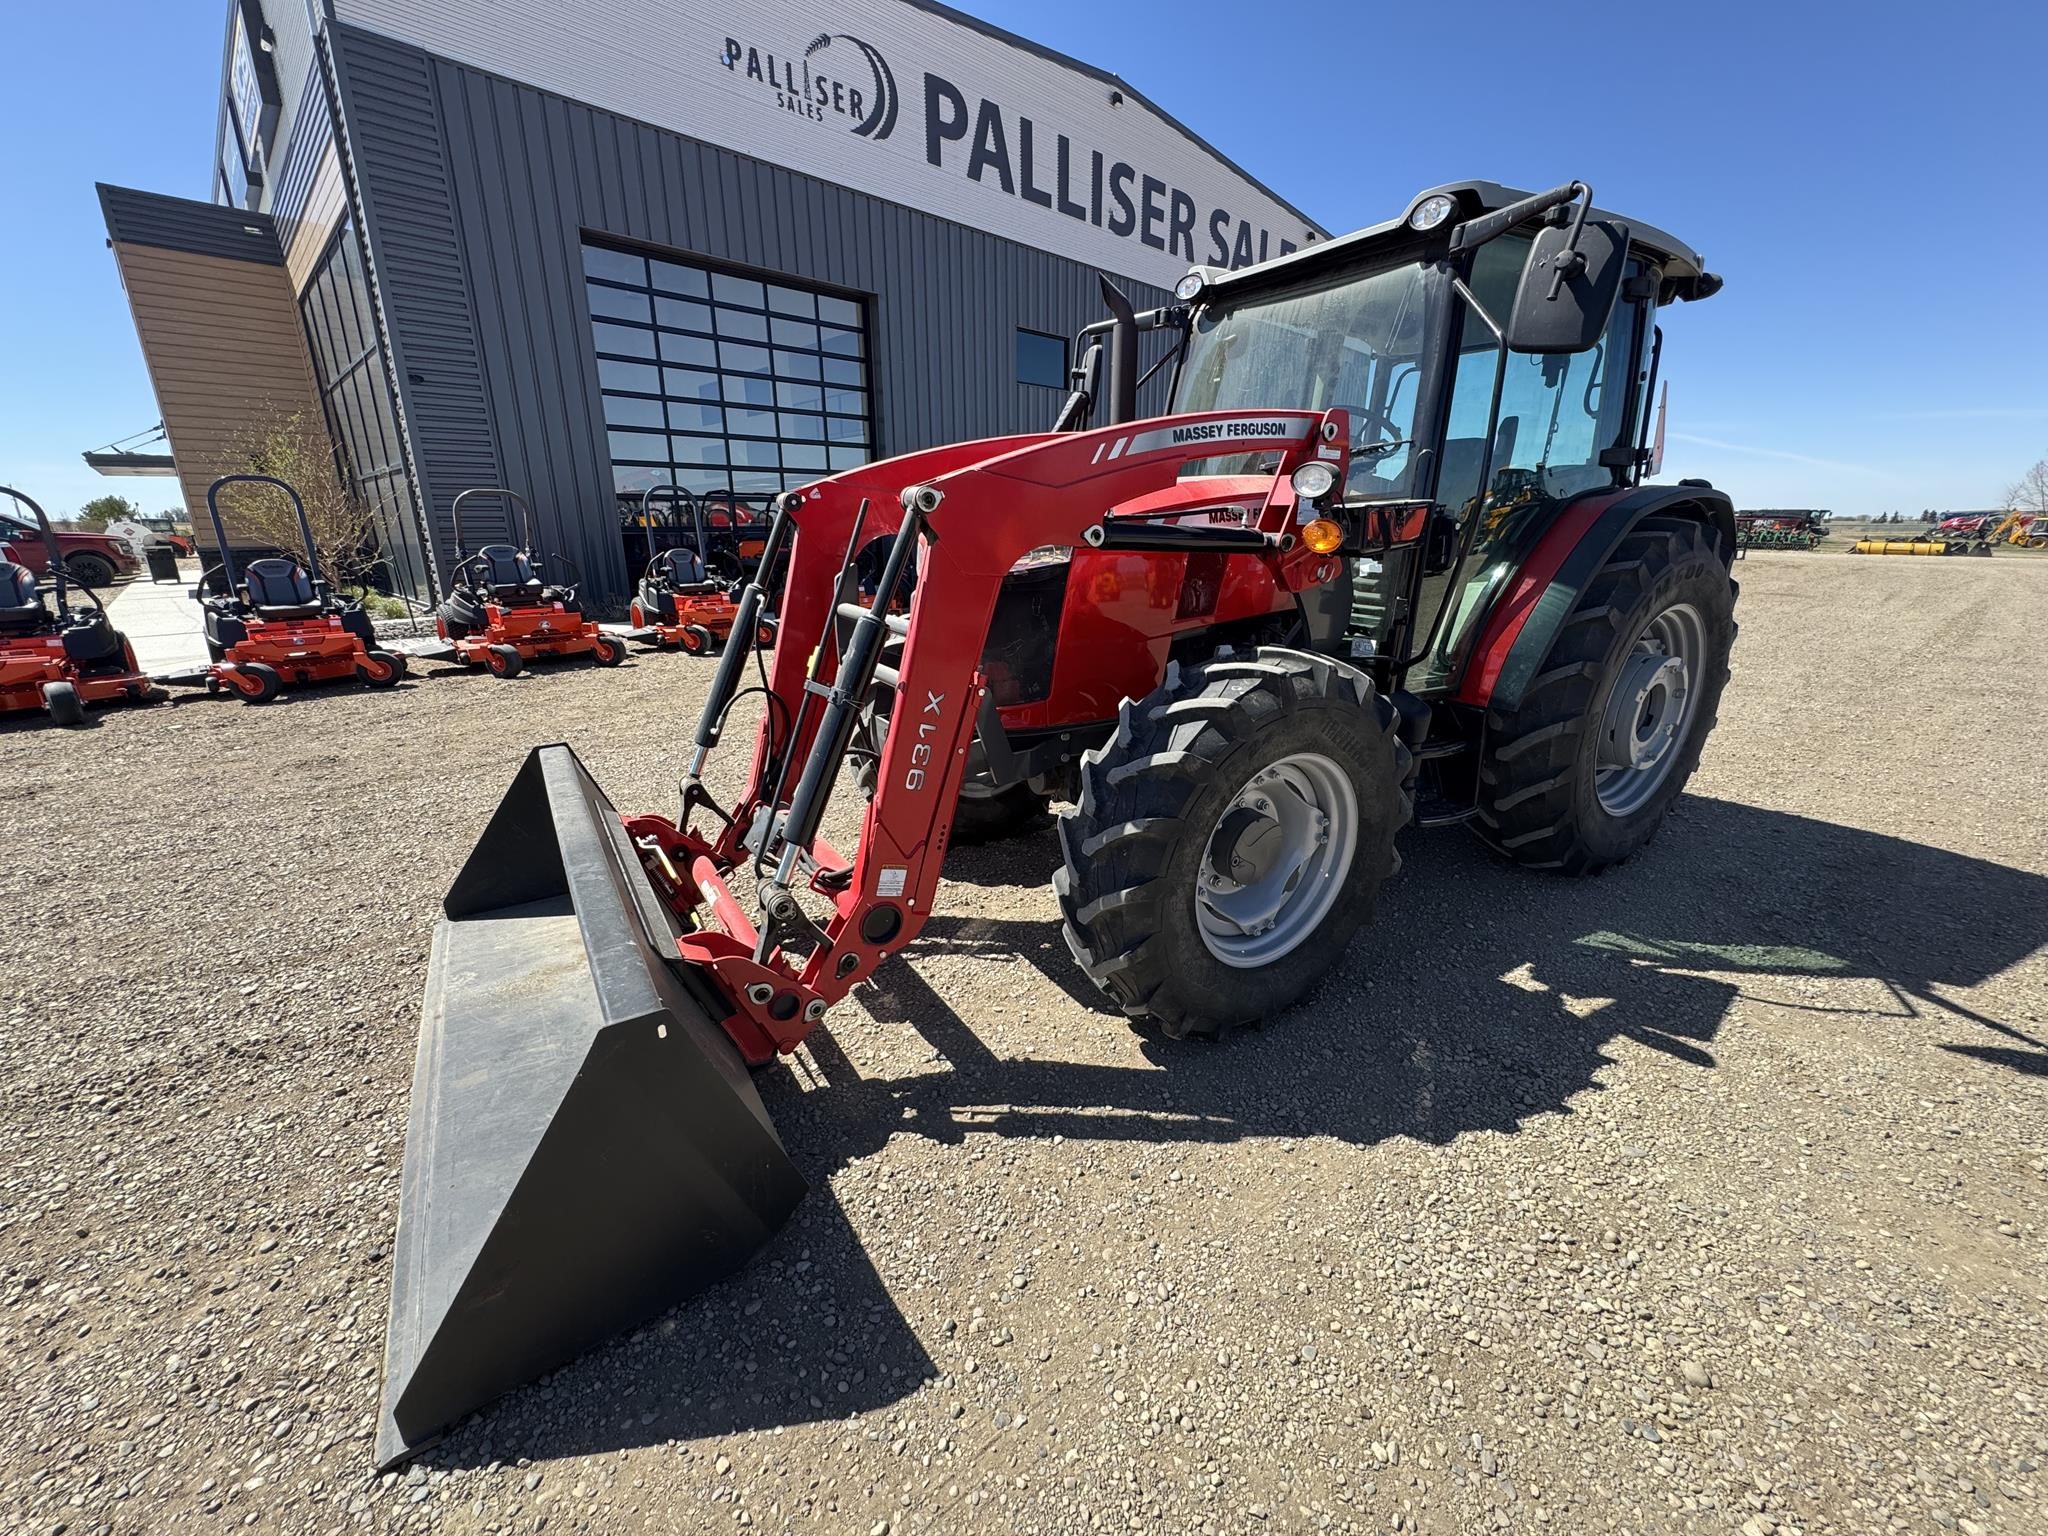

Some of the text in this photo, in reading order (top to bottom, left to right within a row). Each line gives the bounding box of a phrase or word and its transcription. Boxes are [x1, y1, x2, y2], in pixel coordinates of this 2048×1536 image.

[725, 36, 864, 121] PALLISER
[777, 92, 823, 122] SALES
[923, 72, 1297, 272] PALLISER SAL
[1173, 422, 1286, 443] MASSEY FERGUSON
